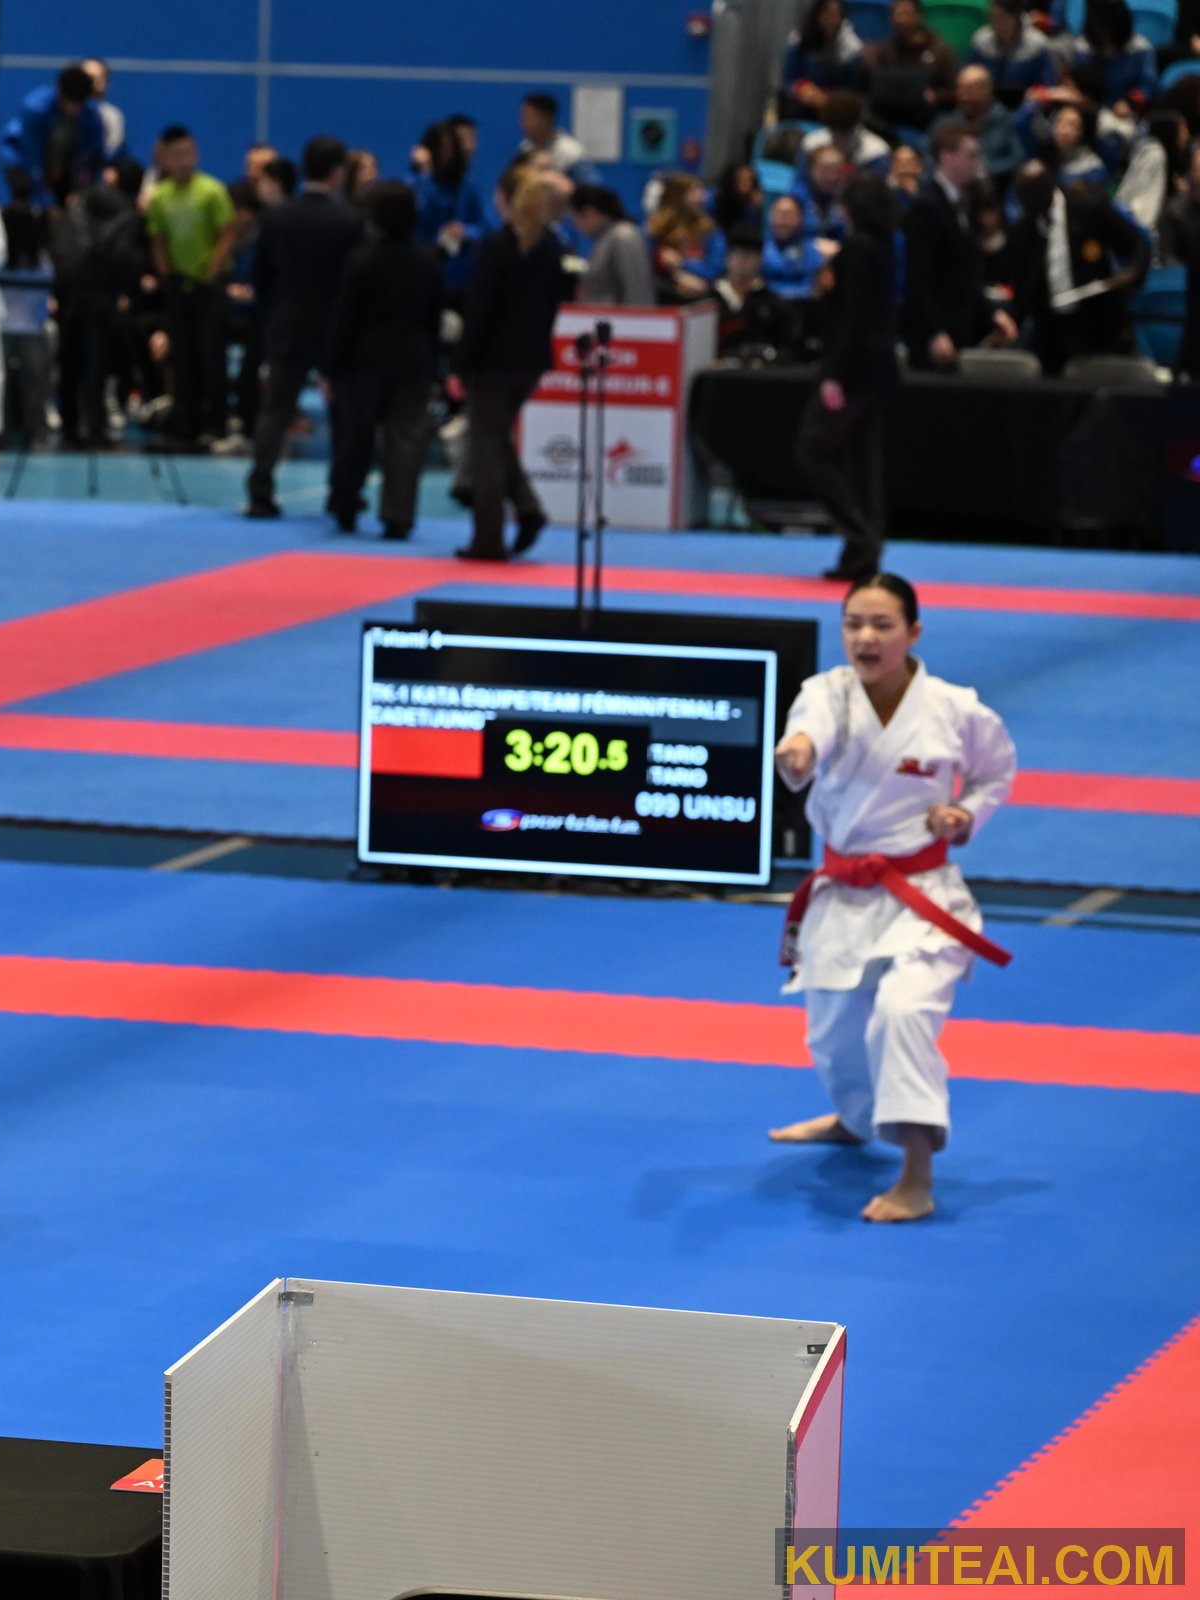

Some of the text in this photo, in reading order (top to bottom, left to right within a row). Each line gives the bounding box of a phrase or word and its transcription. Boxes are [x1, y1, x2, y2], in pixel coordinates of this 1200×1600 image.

[411, 684, 460, 707] KATA
[647, 743, 709, 766] TARIO
[646, 765, 708, 788] TARIO
[682, 793, 756, 822] UNSU
